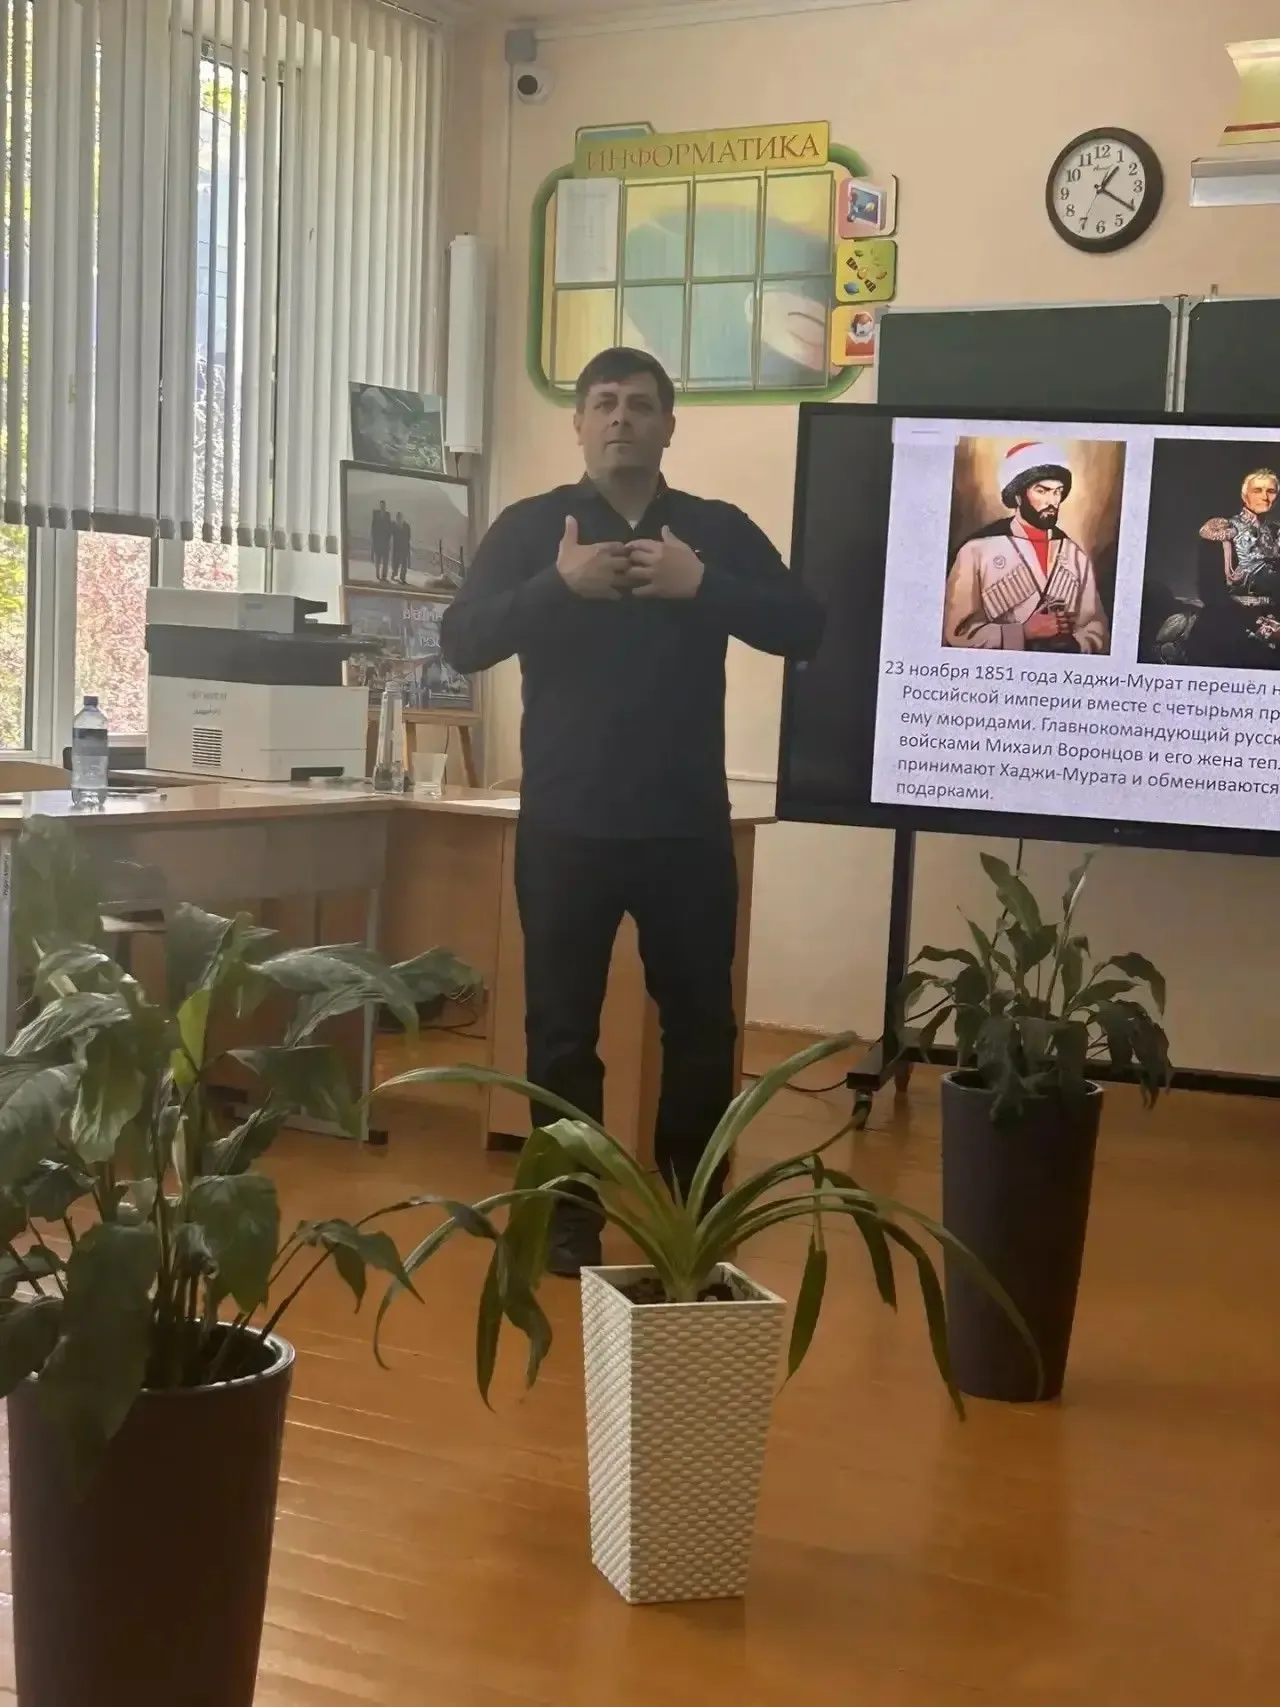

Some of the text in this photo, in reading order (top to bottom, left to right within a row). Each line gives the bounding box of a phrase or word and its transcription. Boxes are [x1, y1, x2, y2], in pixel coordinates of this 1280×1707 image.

[587, 131, 820, 173] ИНФОРМАТИКА
[1095, 144, 1111, 160] 12
[1116, 148, 1125, 163] 1
[1078, 152, 1093, 168] 11
[1066, 168, 1081, 183] 10
[1128, 162, 1138, 176] 2
[1132, 179, 1143, 193] 3
[1060, 187, 1070, 201] 9
[1065, 203, 1076, 218] 8
[1079, 216, 1089, 231] 7
[1096, 220, 1106, 234] 6
[1114, 213, 1124, 227] 5
[884, 660, 904, 676] 23
[909, 663, 969, 681] ноября
[975, 665, 1014, 682] 1851
[1020, 671, 1057, 686] года
[1063, 670, 1183, 692] Хаджи-Мурат
[1187, 679, 1267, 697] перешёл
[903, 686, 999, 705] Российской
[1004, 694, 1082, 711] империи
[1087, 698, 1147, 713] вместе
[1152, 703, 1161, 714] с
[1166, 703, 1254, 721] четырьмя
[900, 712, 932, 729] ему
[937, 716, 1036, 734] мюридами.
[1041, 717, 1229, 742] Главнокомандующий
[899, 733, 980, 751] войсками
[986, 738, 1052, 756] Михаил
[1057, 743, 1143, 763] Воронцов
[1149, 752, 1159, 762] и
[1164, 752, 1193, 765] его
[1197, 754, 1243, 768] жена
[897, 758, 1280, 795] принимают Хаджи-Мурата и обмениваются
[896, 782, 994, 800] подарками.
